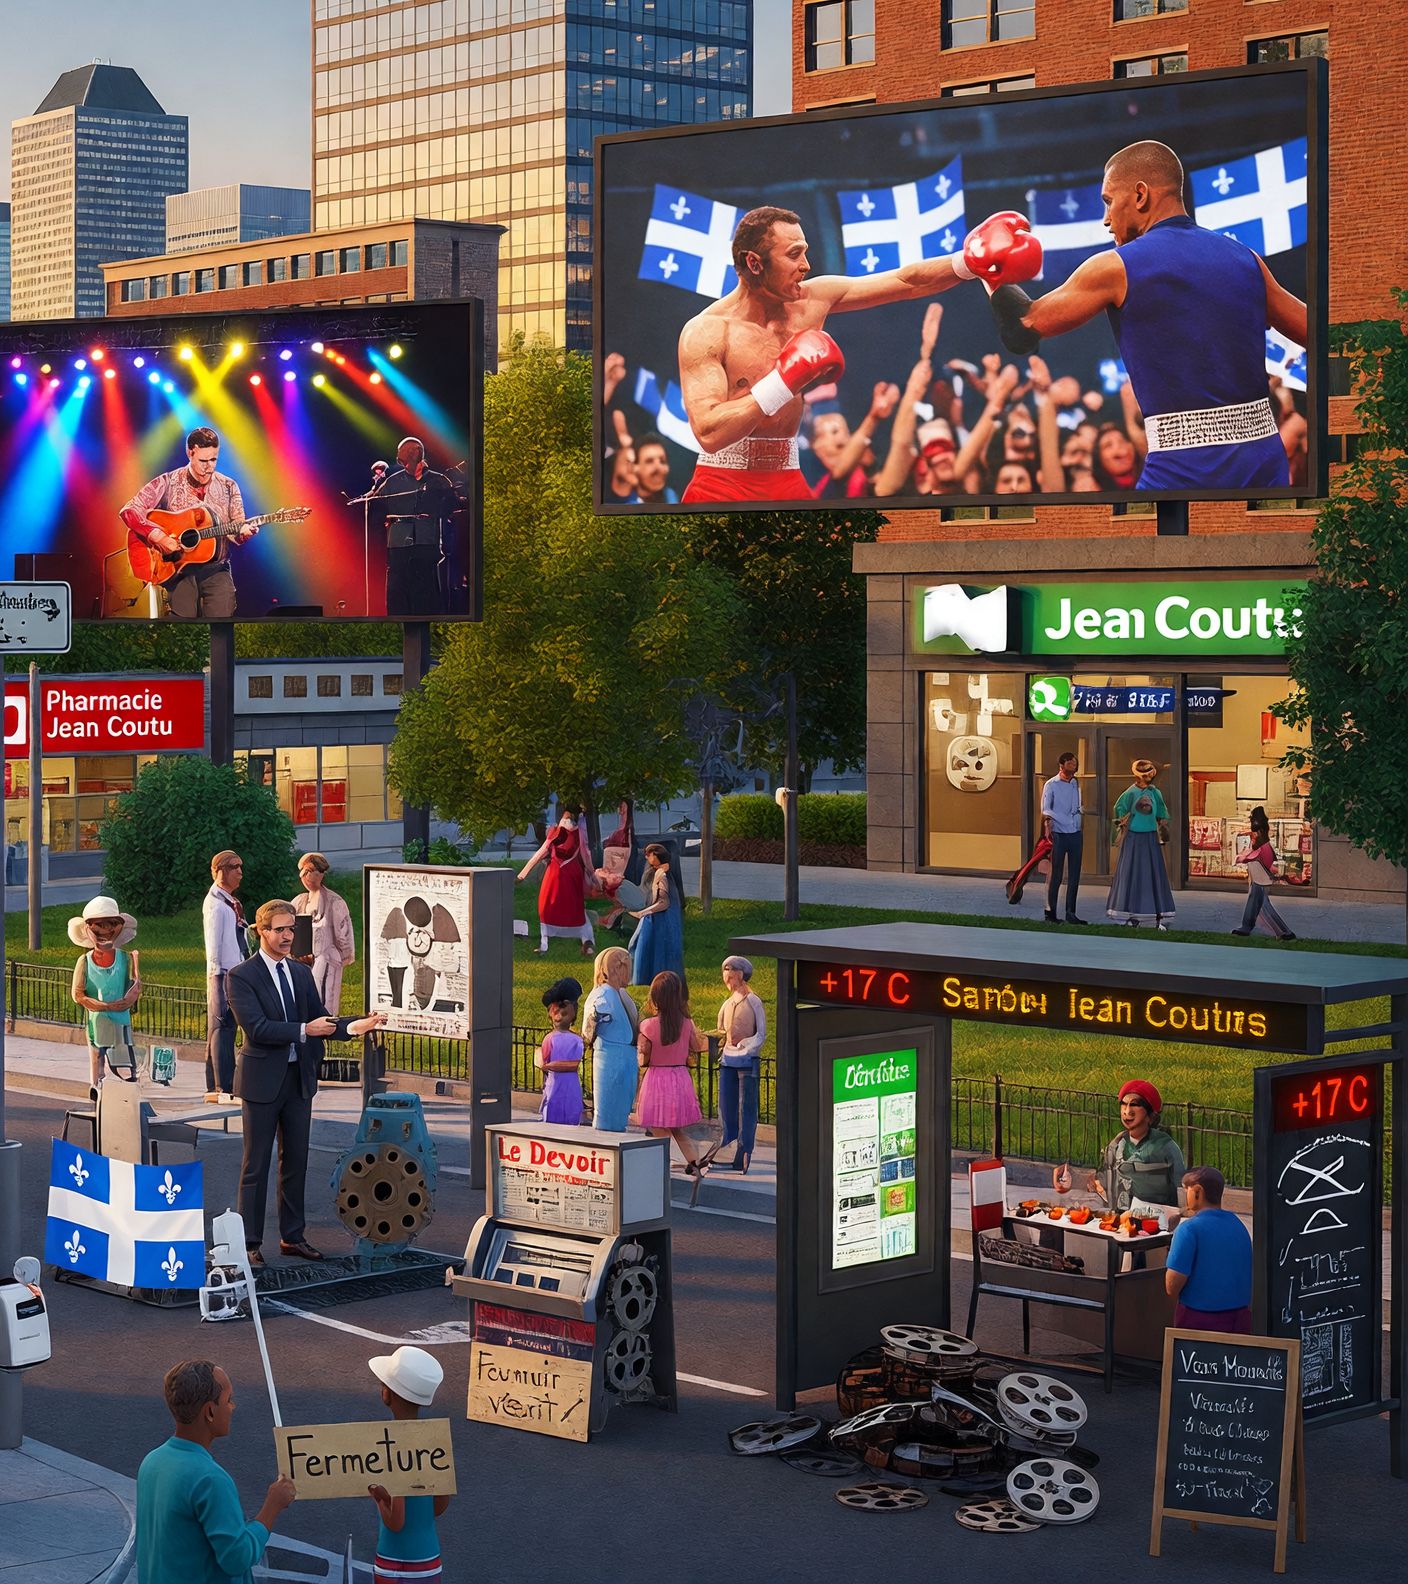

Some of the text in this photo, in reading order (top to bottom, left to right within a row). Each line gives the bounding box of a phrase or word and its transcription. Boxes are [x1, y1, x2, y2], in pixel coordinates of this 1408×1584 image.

[46, 688, 163, 712] Pharmacie
[46, 715, 173, 739] Jean Coutu
[497, 1135, 611, 1176] Le Devoir
[286, 1427, 451, 1480] Fermeture
